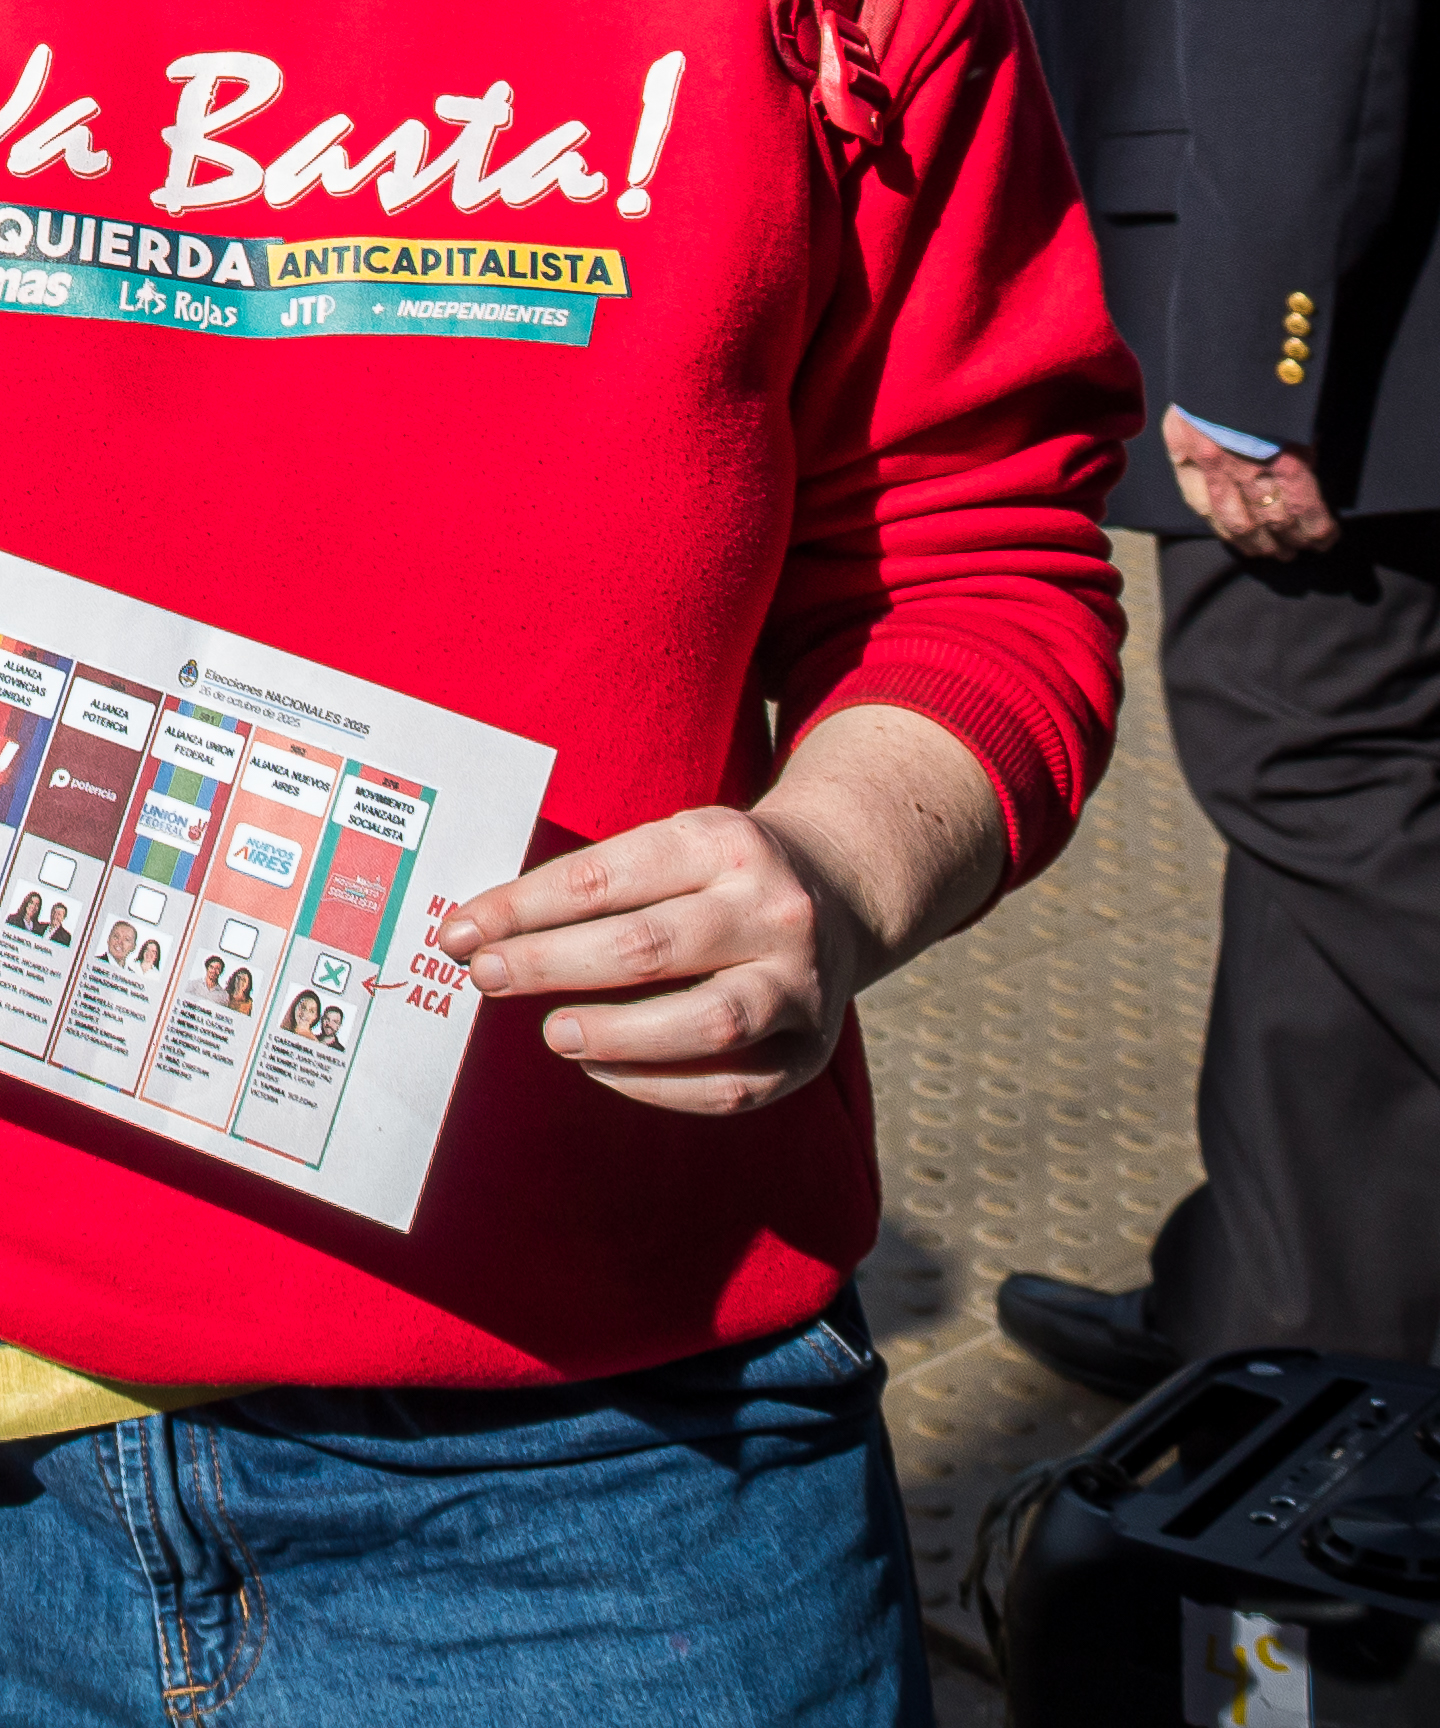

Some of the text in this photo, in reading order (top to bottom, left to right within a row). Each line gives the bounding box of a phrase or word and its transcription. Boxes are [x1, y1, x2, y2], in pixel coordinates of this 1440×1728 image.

[149, 48, 686, 221] Basta!
[276, 244, 616, 288] ANTICAPITALISTA
[281, 293, 338, 328] JTP
[396, 299, 570, 328] INDEPENDIENTES
[3, 658, 43, 681] ALIANZA
[89, 698, 130, 720] ALIANZA
[198, 685, 302, 729] 26 de octubre de 2025
[203, 667, 371, 735] Elecciones NACIONALES 2025
[81, 710, 129, 735] POTENCIA
[164, 724, 235, 758] ALIANZA UNION
[173, 743, 216, 767] FEDERAL
[249, 755, 331, 793] ALIANZA NUEVOS
[271, 778, 300, 797] AIRES
[69, 775, 117, 803] potencia
[354, 785, 416, 815] MOVIMIENTO
[139, 813, 185, 837] FEDERAL
[142, 799, 190, 828] UNIÓN
[347, 813, 405, 843] SOCIALISTA
[353, 800, 406, 828] AVANZADA
[233, 843, 292, 876] AIRES
[246, 836, 294, 861] NUEVOS
[410, 952, 470, 991] CRUZ
